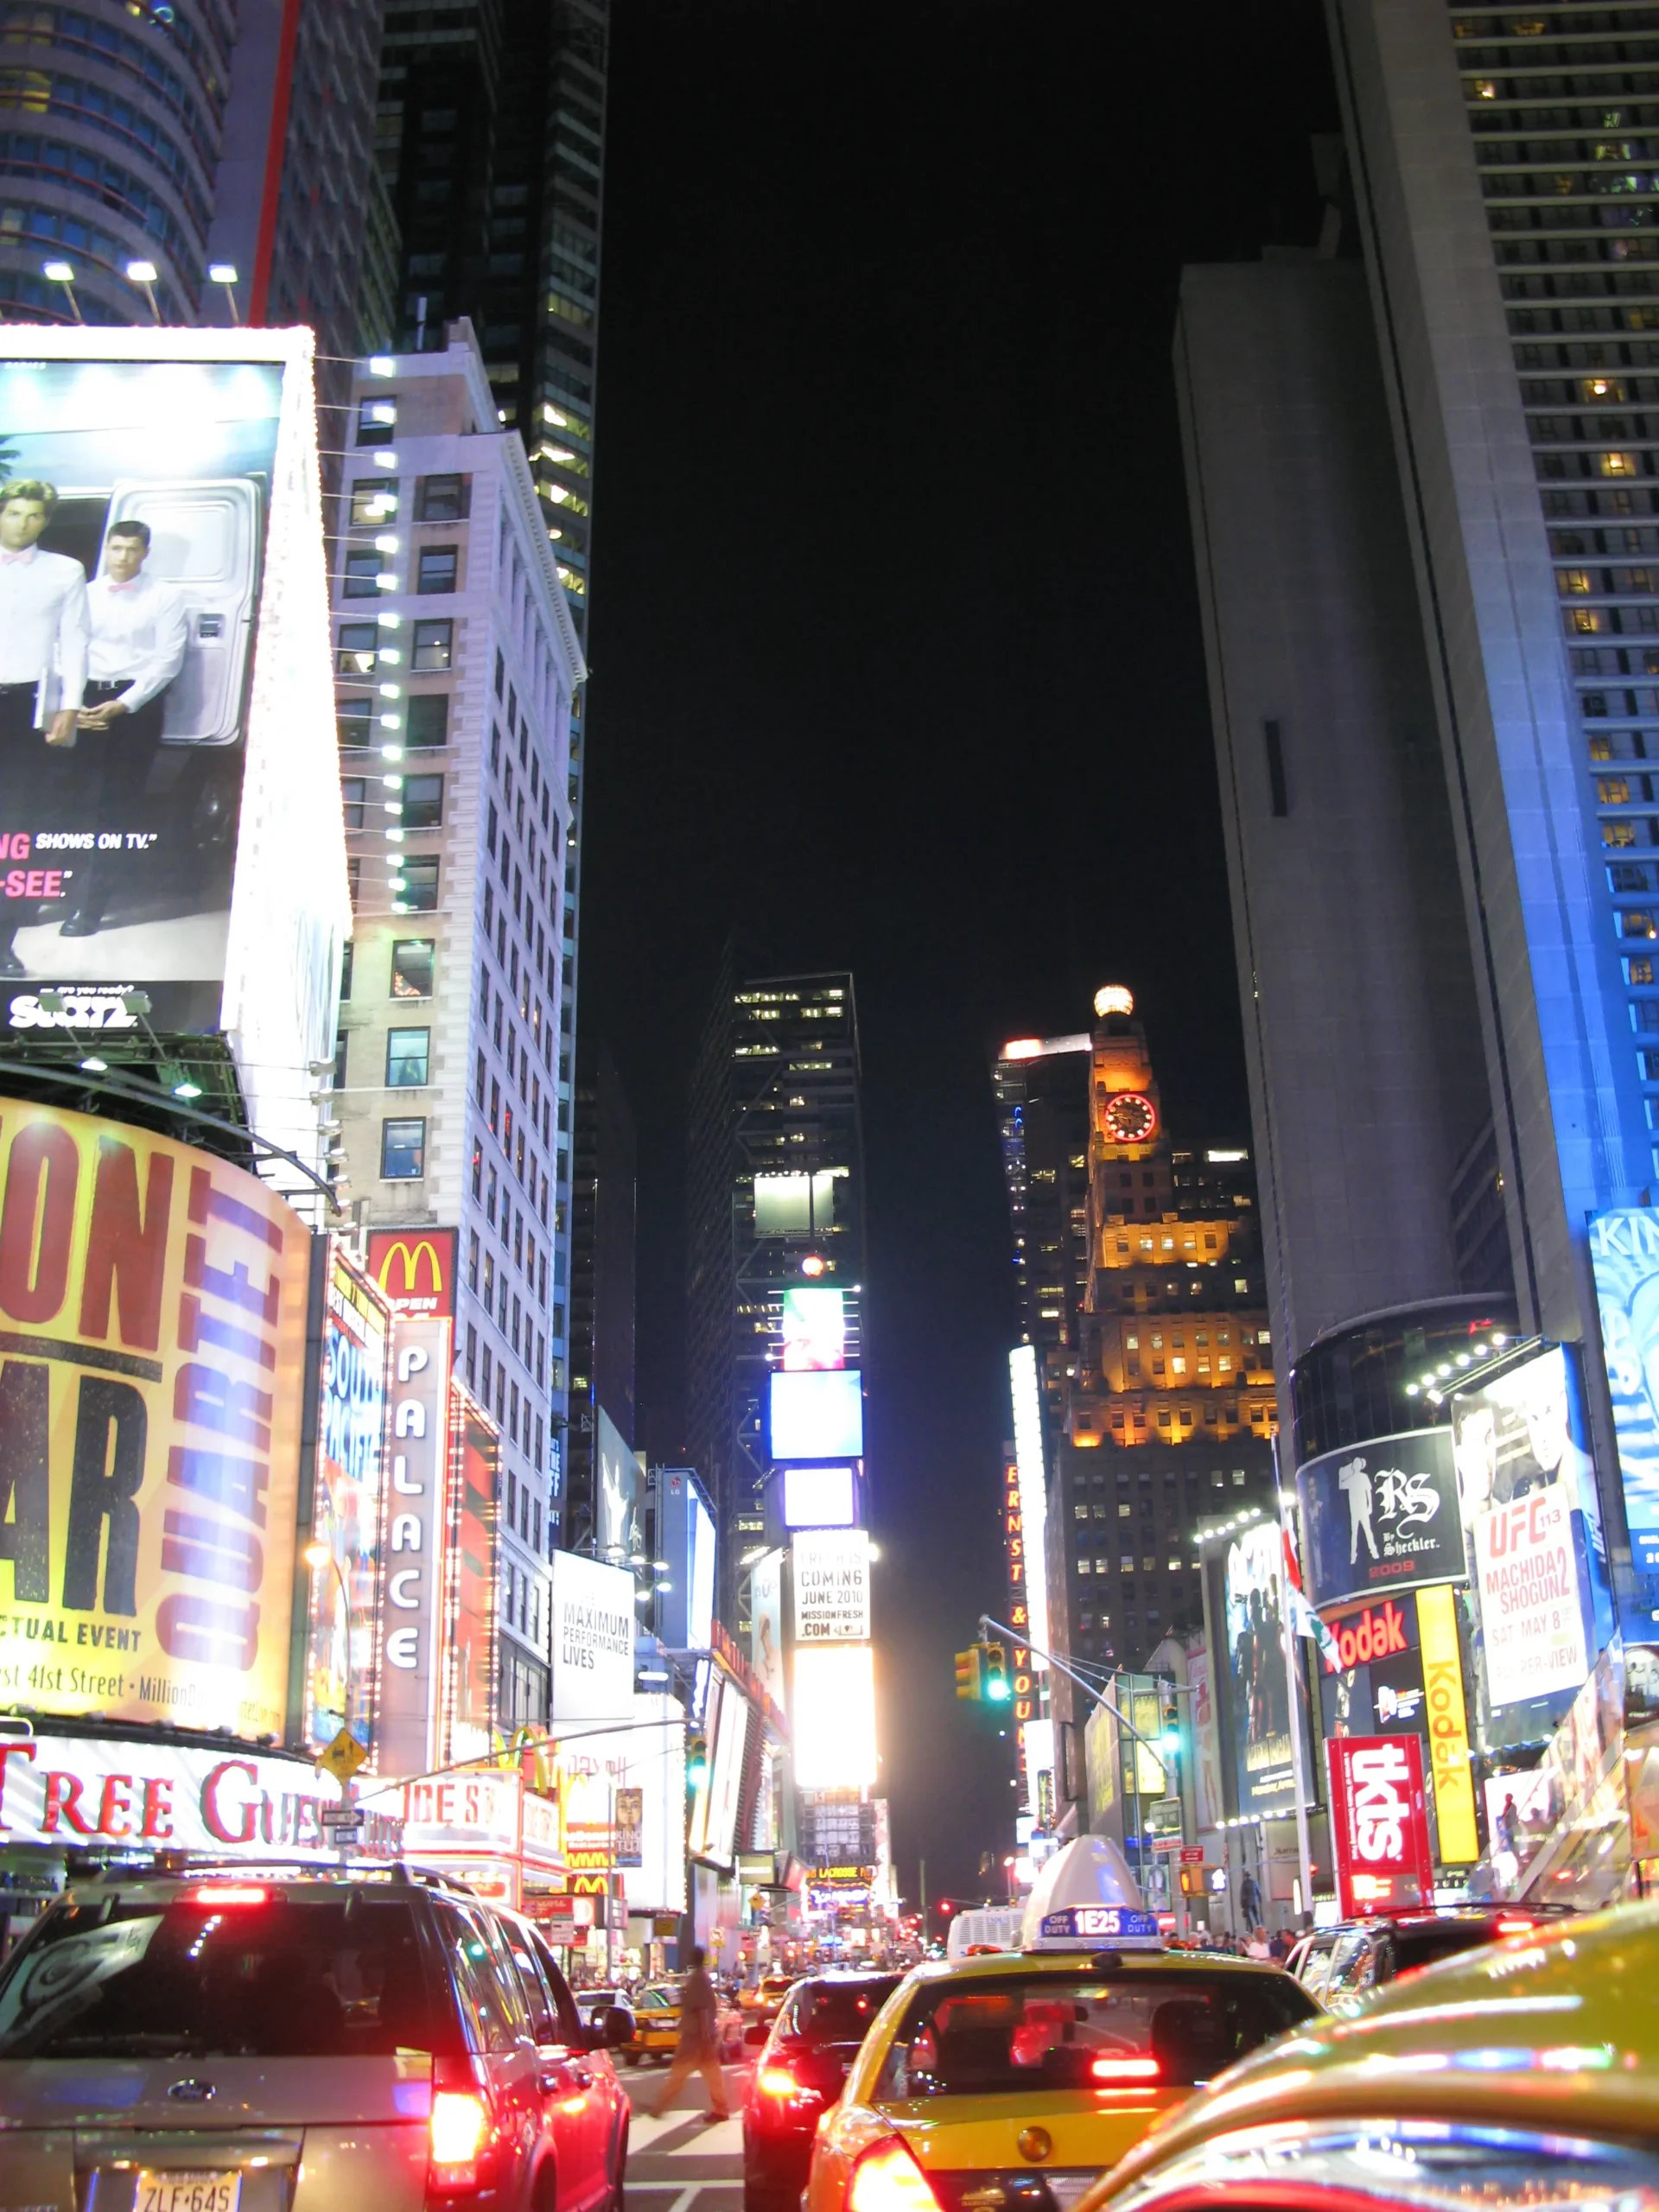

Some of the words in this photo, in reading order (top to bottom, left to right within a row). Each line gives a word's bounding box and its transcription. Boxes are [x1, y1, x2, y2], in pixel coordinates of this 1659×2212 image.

[35, 833, 95, 849] SHOWS
[98, 834, 123, 849] ON
[385, 1344, 429, 1669] PALACE
[1373, 1467, 1440, 1539] RS
[1007, 1465, 1023, 1581] ERNST
[1489, 1496, 1547, 1560] UFC
[1540, 1509, 1561, 1529] 113
[1383, 1537, 1436, 1557] Sheckler
[800, 1569, 863, 1587] COMING
[1369, 1560, 1415, 1579] 2009
[1485, 1549, 1557, 1595] MACHIDA
[1556, 1546, 1571, 1597] 2
[801, 1591, 833, 1605] JUNE
[836, 1590, 863, 1604] 2010
[1500, 1576, 1560, 1615] SHOGUN
[563, 1601, 629, 1639] MAXIMUM
[800, 1610, 864, 1621] MISSIONFRESH
[801, 1623, 831, 1637] .COM
[1012, 1605, 1027, 1624] &
[1492, 1624, 1514, 1647] SAT
[1521, 1614, 1548, 1639] MAY
[1553, 1611, 1561, 1630] 8
[77, 1623, 142, 1652] EVENT
[563, 1625, 629, 1656] PERFORMANCE
[563, 1643, 594, 1669] LIVES
[28, 1664, 63, 1691] 41st
[70, 1667, 124, 1698] Street
[1427, 1661, 1465, 1791] Kodak
[200, 1760, 338, 1850] GUES
[1351, 1743, 1410, 1861] tkts
[1044, 1924, 1071, 1935] DUTY
[1127, 1924, 1153, 1933] DUTY
[1049, 1915, 1069, 1924] OFF
[1074, 1909, 1122, 1935] 1E25
[1130, 1914, 1148, 1923] OFF
